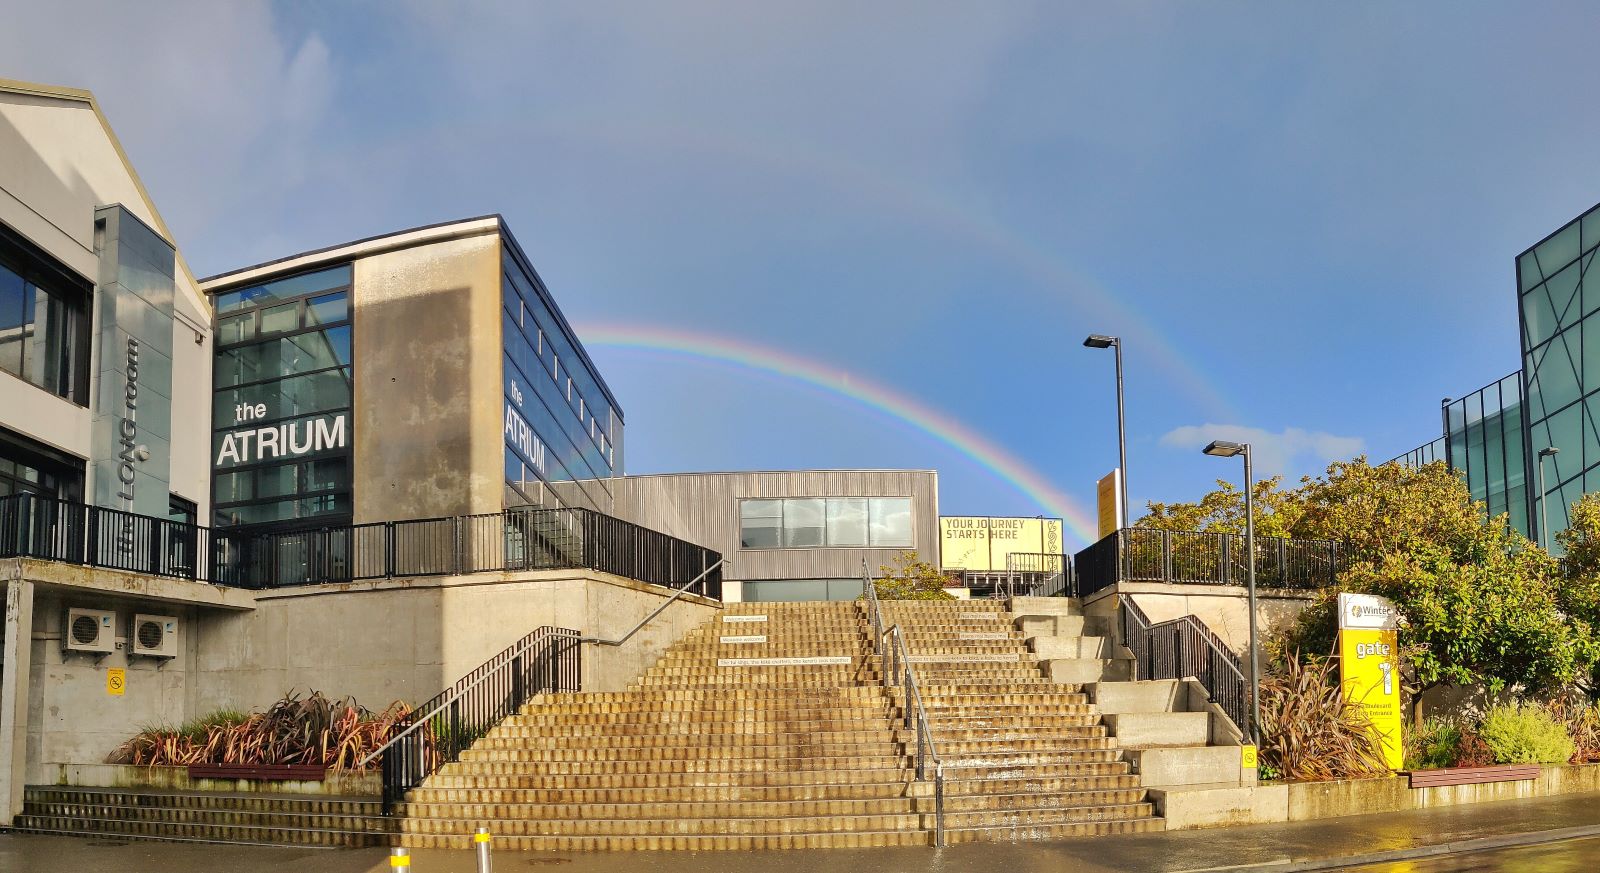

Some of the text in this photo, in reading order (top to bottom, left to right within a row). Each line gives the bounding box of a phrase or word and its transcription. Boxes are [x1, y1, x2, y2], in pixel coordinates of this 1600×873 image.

[125, 338, 139, 410] room
[511, 379, 523, 407] the
[235, 402, 267, 422] the
[216, 415, 345, 466] ATRIUM
[505, 404, 545, 474] ATRIUM
[117, 417, 137, 501] LONG
[946, 519, 1025, 529] YOUR JOURNEY
[946, 529, 1018, 539] STARTS HERE
[1362, 606, 1392, 616] Wintec
[1356, 641, 1391, 660] gate
[1379, 662, 1393, 695] 1
